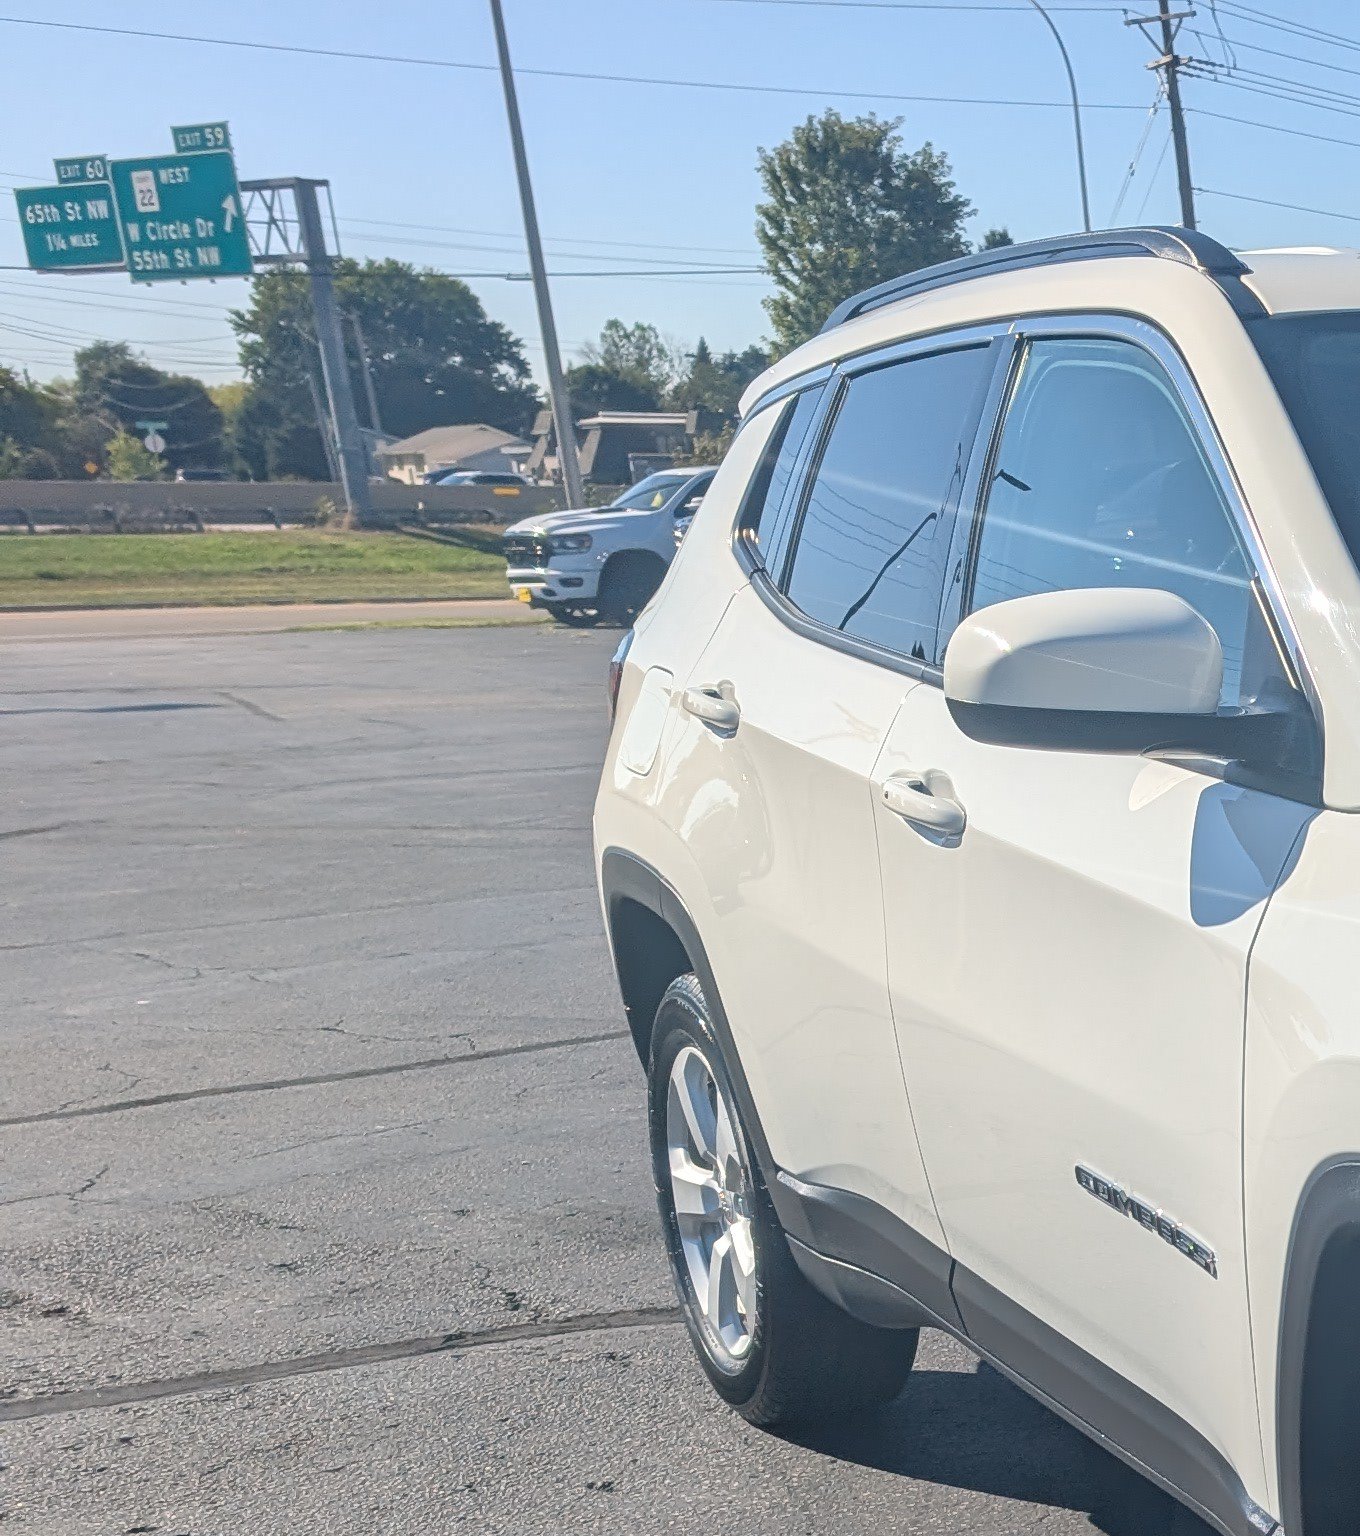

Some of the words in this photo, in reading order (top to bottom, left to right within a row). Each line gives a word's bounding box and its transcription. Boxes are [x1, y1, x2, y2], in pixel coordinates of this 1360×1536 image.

[178, 131, 201, 148] EXIT
[204, 126, 225, 148] 59
[60, 164, 81, 179] EXIT
[86, 159, 105, 179] 60
[159, 166, 190, 184] WEST
[139, 189, 156, 207] 22
[25, 205, 61, 225] 65th
[64, 202, 82, 221] St
[86, 200, 109, 219] NW
[69, 232, 99, 247] MILES
[127, 222, 140, 242] W
[145, 219, 191, 241] Circle
[196, 217, 215, 237] Dr
[132, 250, 171, 271] 55th
[172, 248, 193, 269] St
[197, 246, 220, 266] NW
